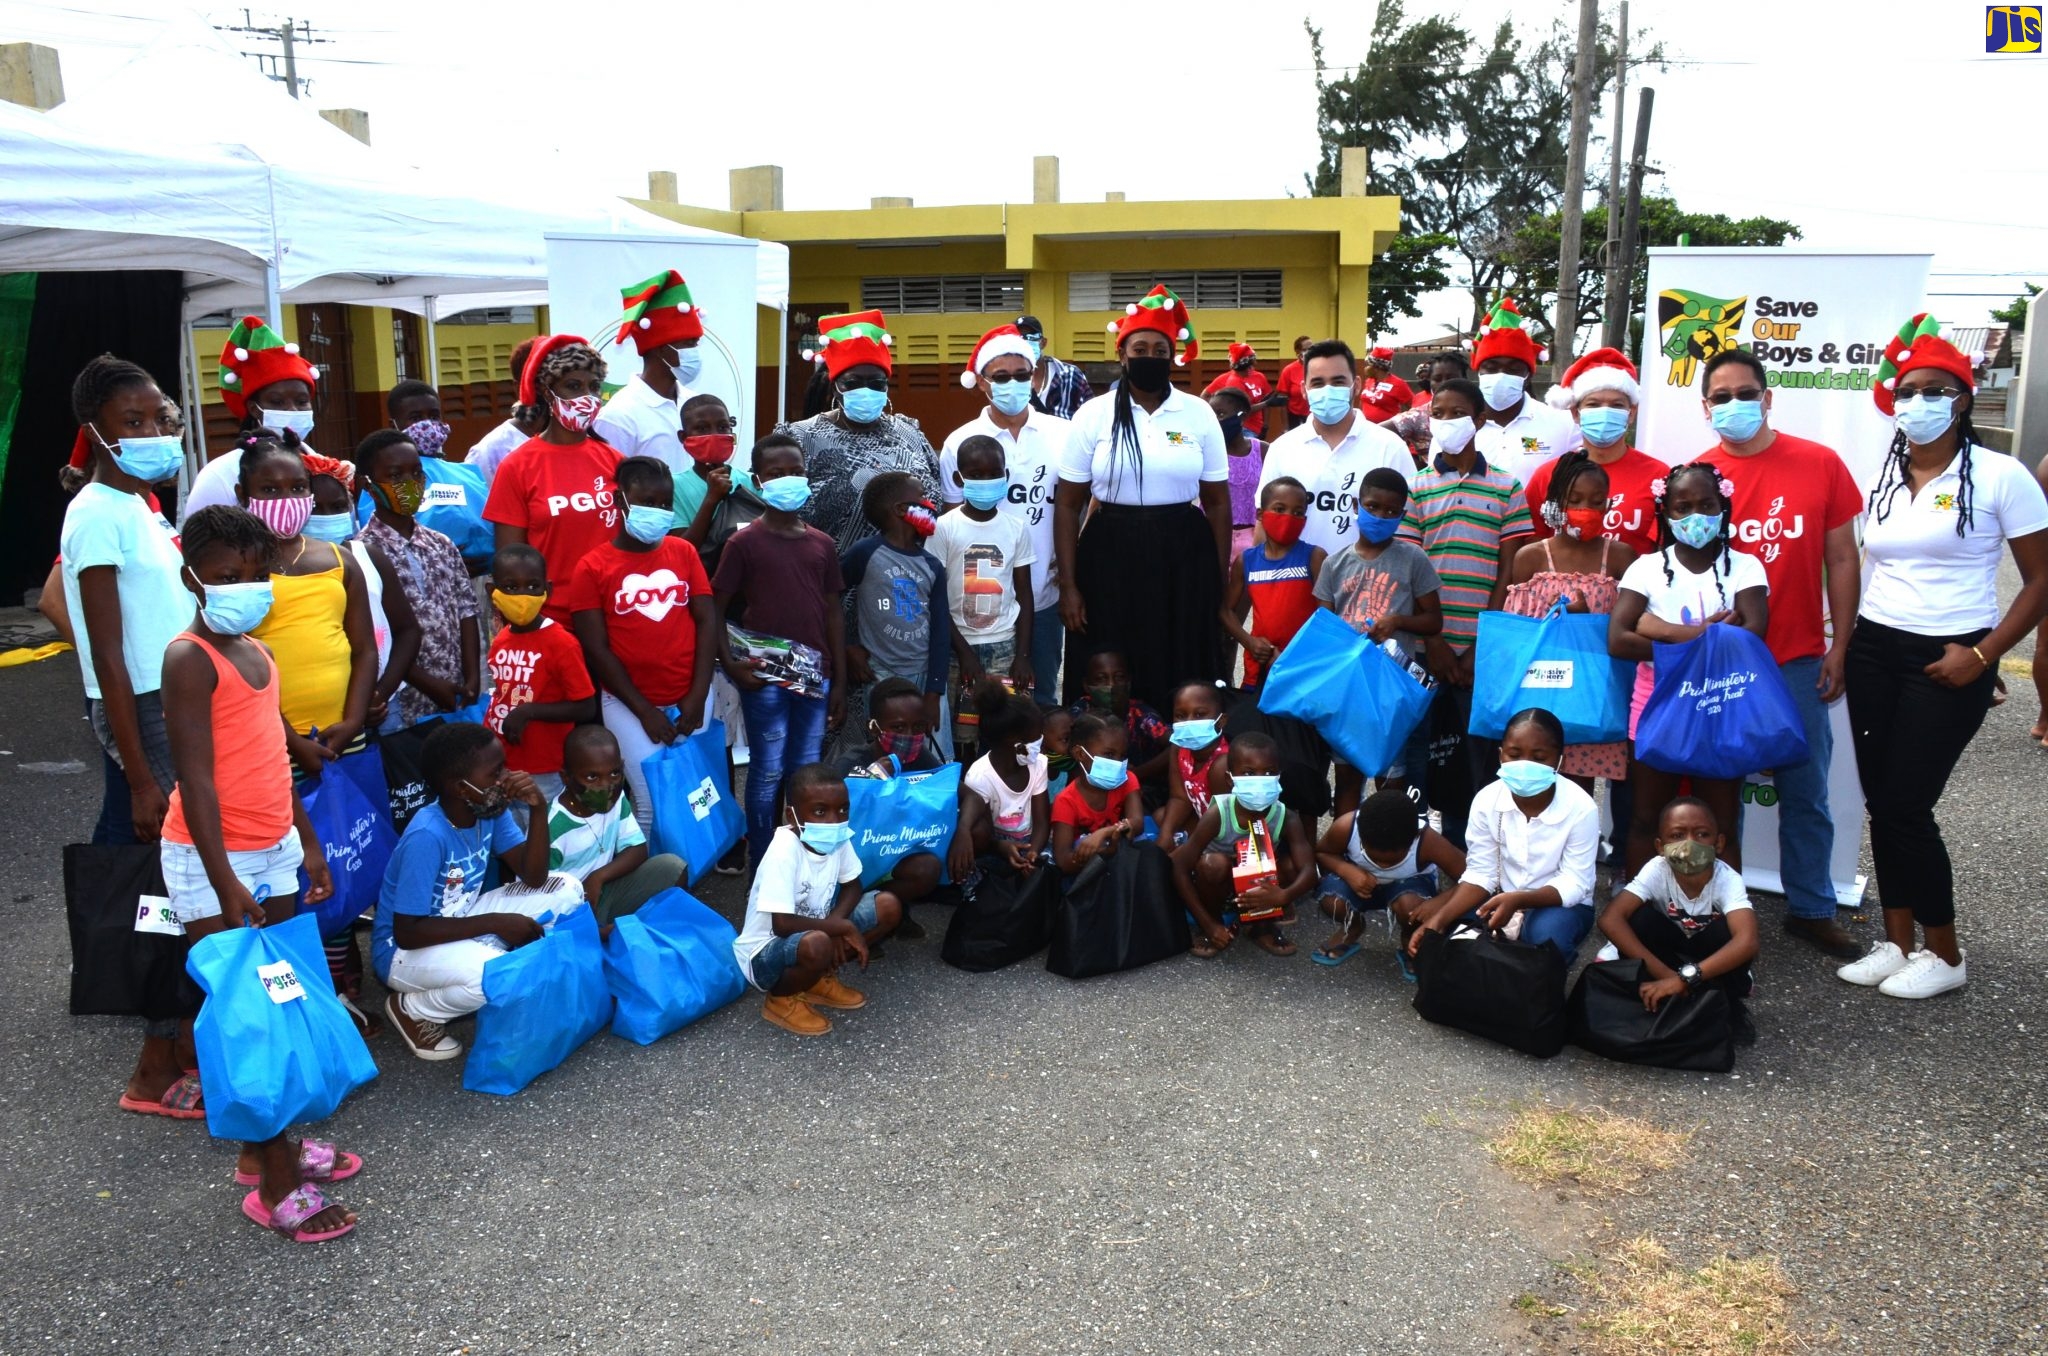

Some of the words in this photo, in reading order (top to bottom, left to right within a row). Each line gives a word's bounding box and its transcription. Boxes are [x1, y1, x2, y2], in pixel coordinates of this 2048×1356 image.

[1755, 296, 1818, 318] Save
[1753, 318, 1801, 341] Our
[1753, 341, 1813, 367] Boys
[1819, 343, 1840, 364] &
[1846, 343, 1887, 365] Gir
[547, 491, 614, 517] PGO
[963, 543, 1005, 630] 6
[616, 584, 688, 613] LOVE
[878, 598, 890, 610] 19
[495, 648, 542, 667] ONLY
[514, 665, 534, 683] IT
[1722, 687, 1746, 702] Treat
[861, 828, 898, 847] Prime
[900, 823, 948, 842] Minister's
